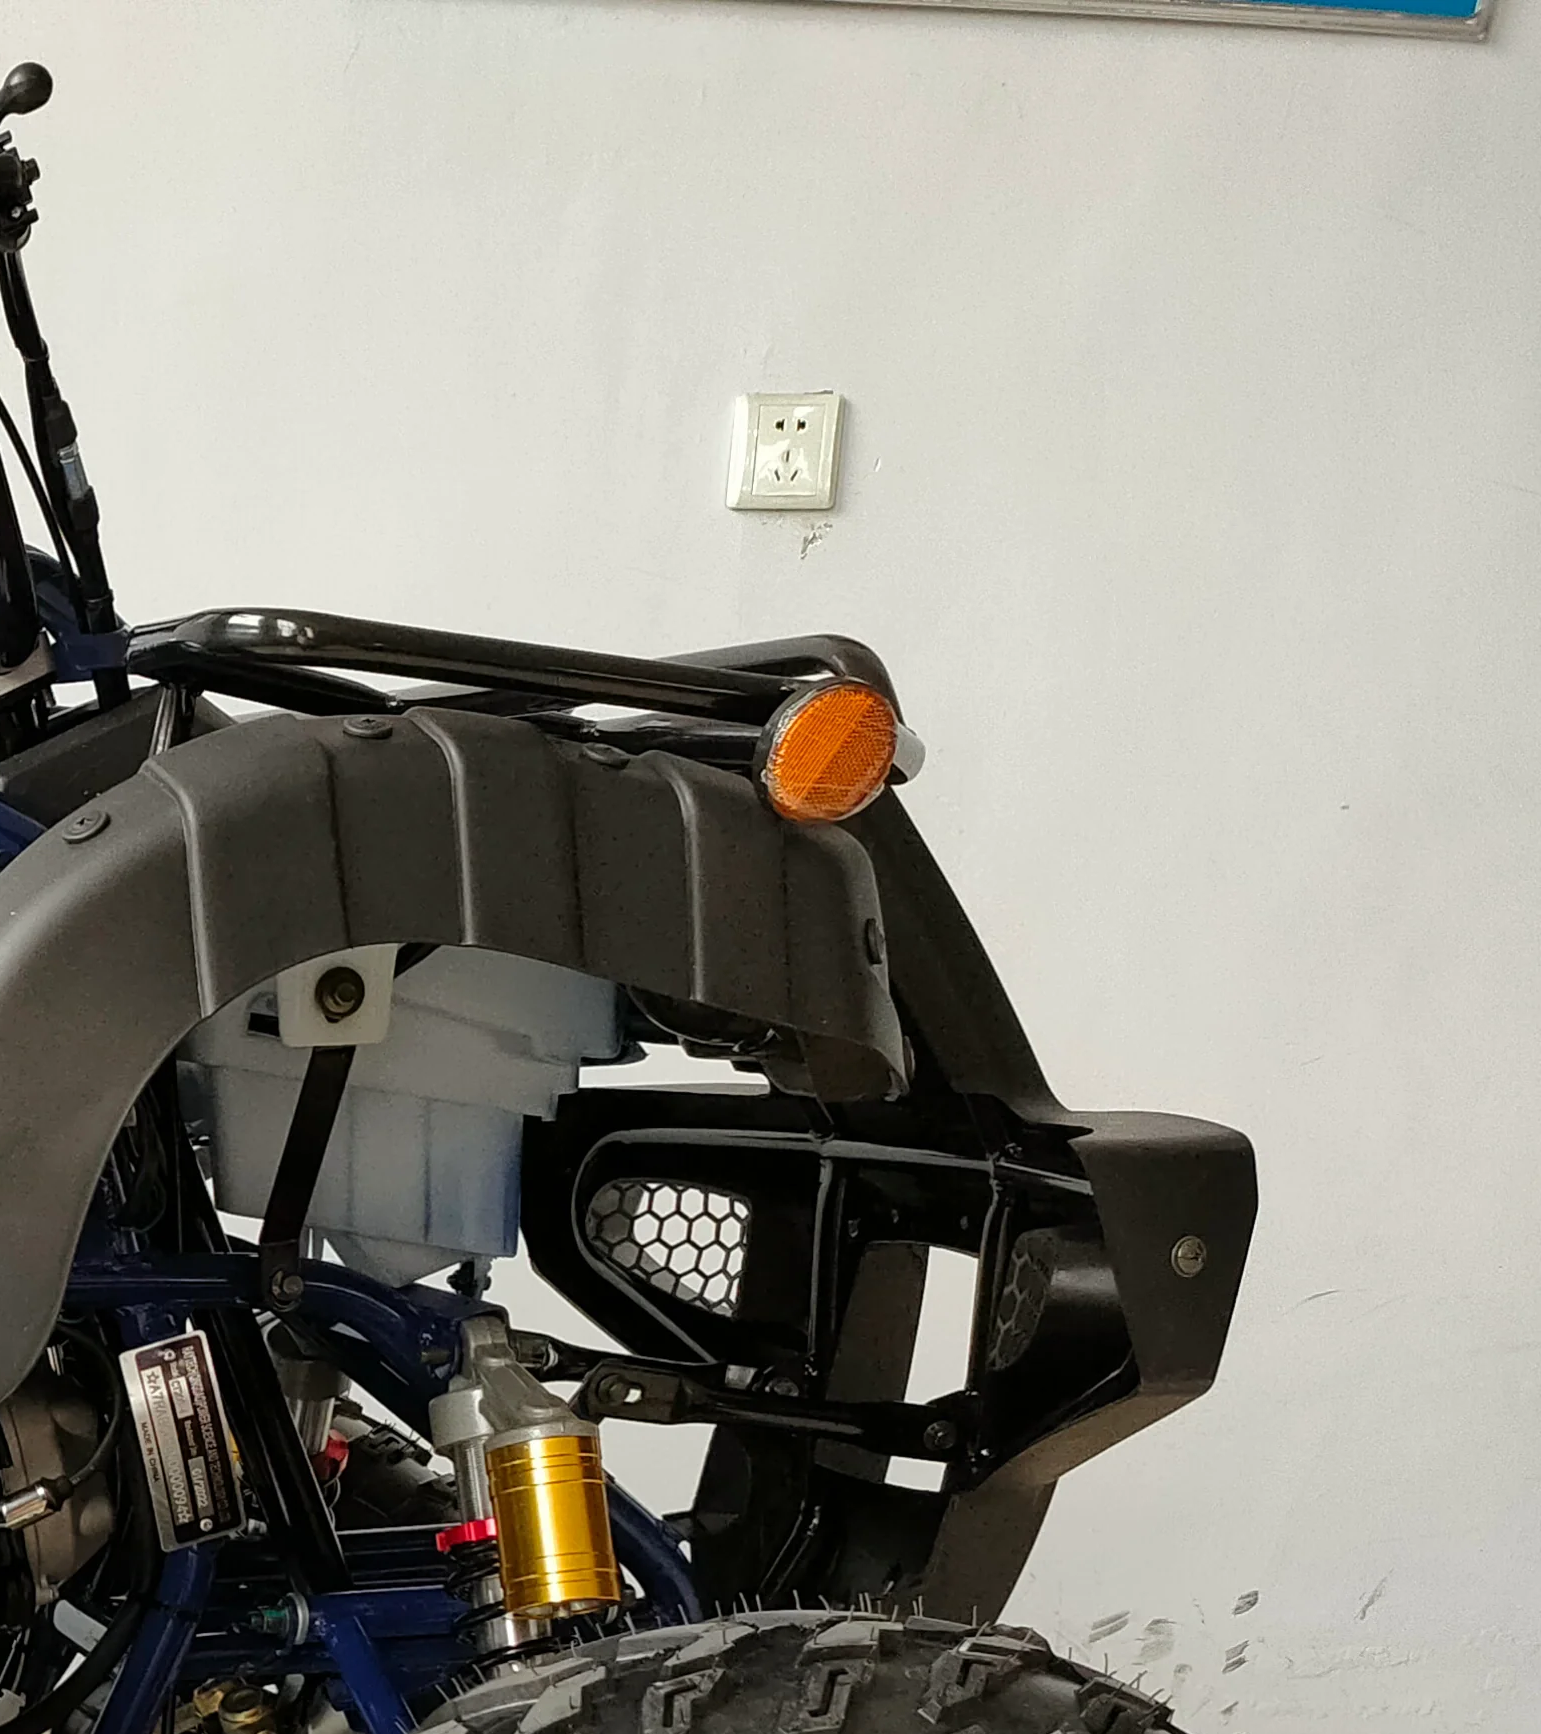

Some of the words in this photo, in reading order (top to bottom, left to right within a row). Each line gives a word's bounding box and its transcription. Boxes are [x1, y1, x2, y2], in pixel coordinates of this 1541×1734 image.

[140, 1421, 152, 1446] MADE
[146, 1446, 154, 1456] IN
[148, 1457, 161, 1483] CHINA
